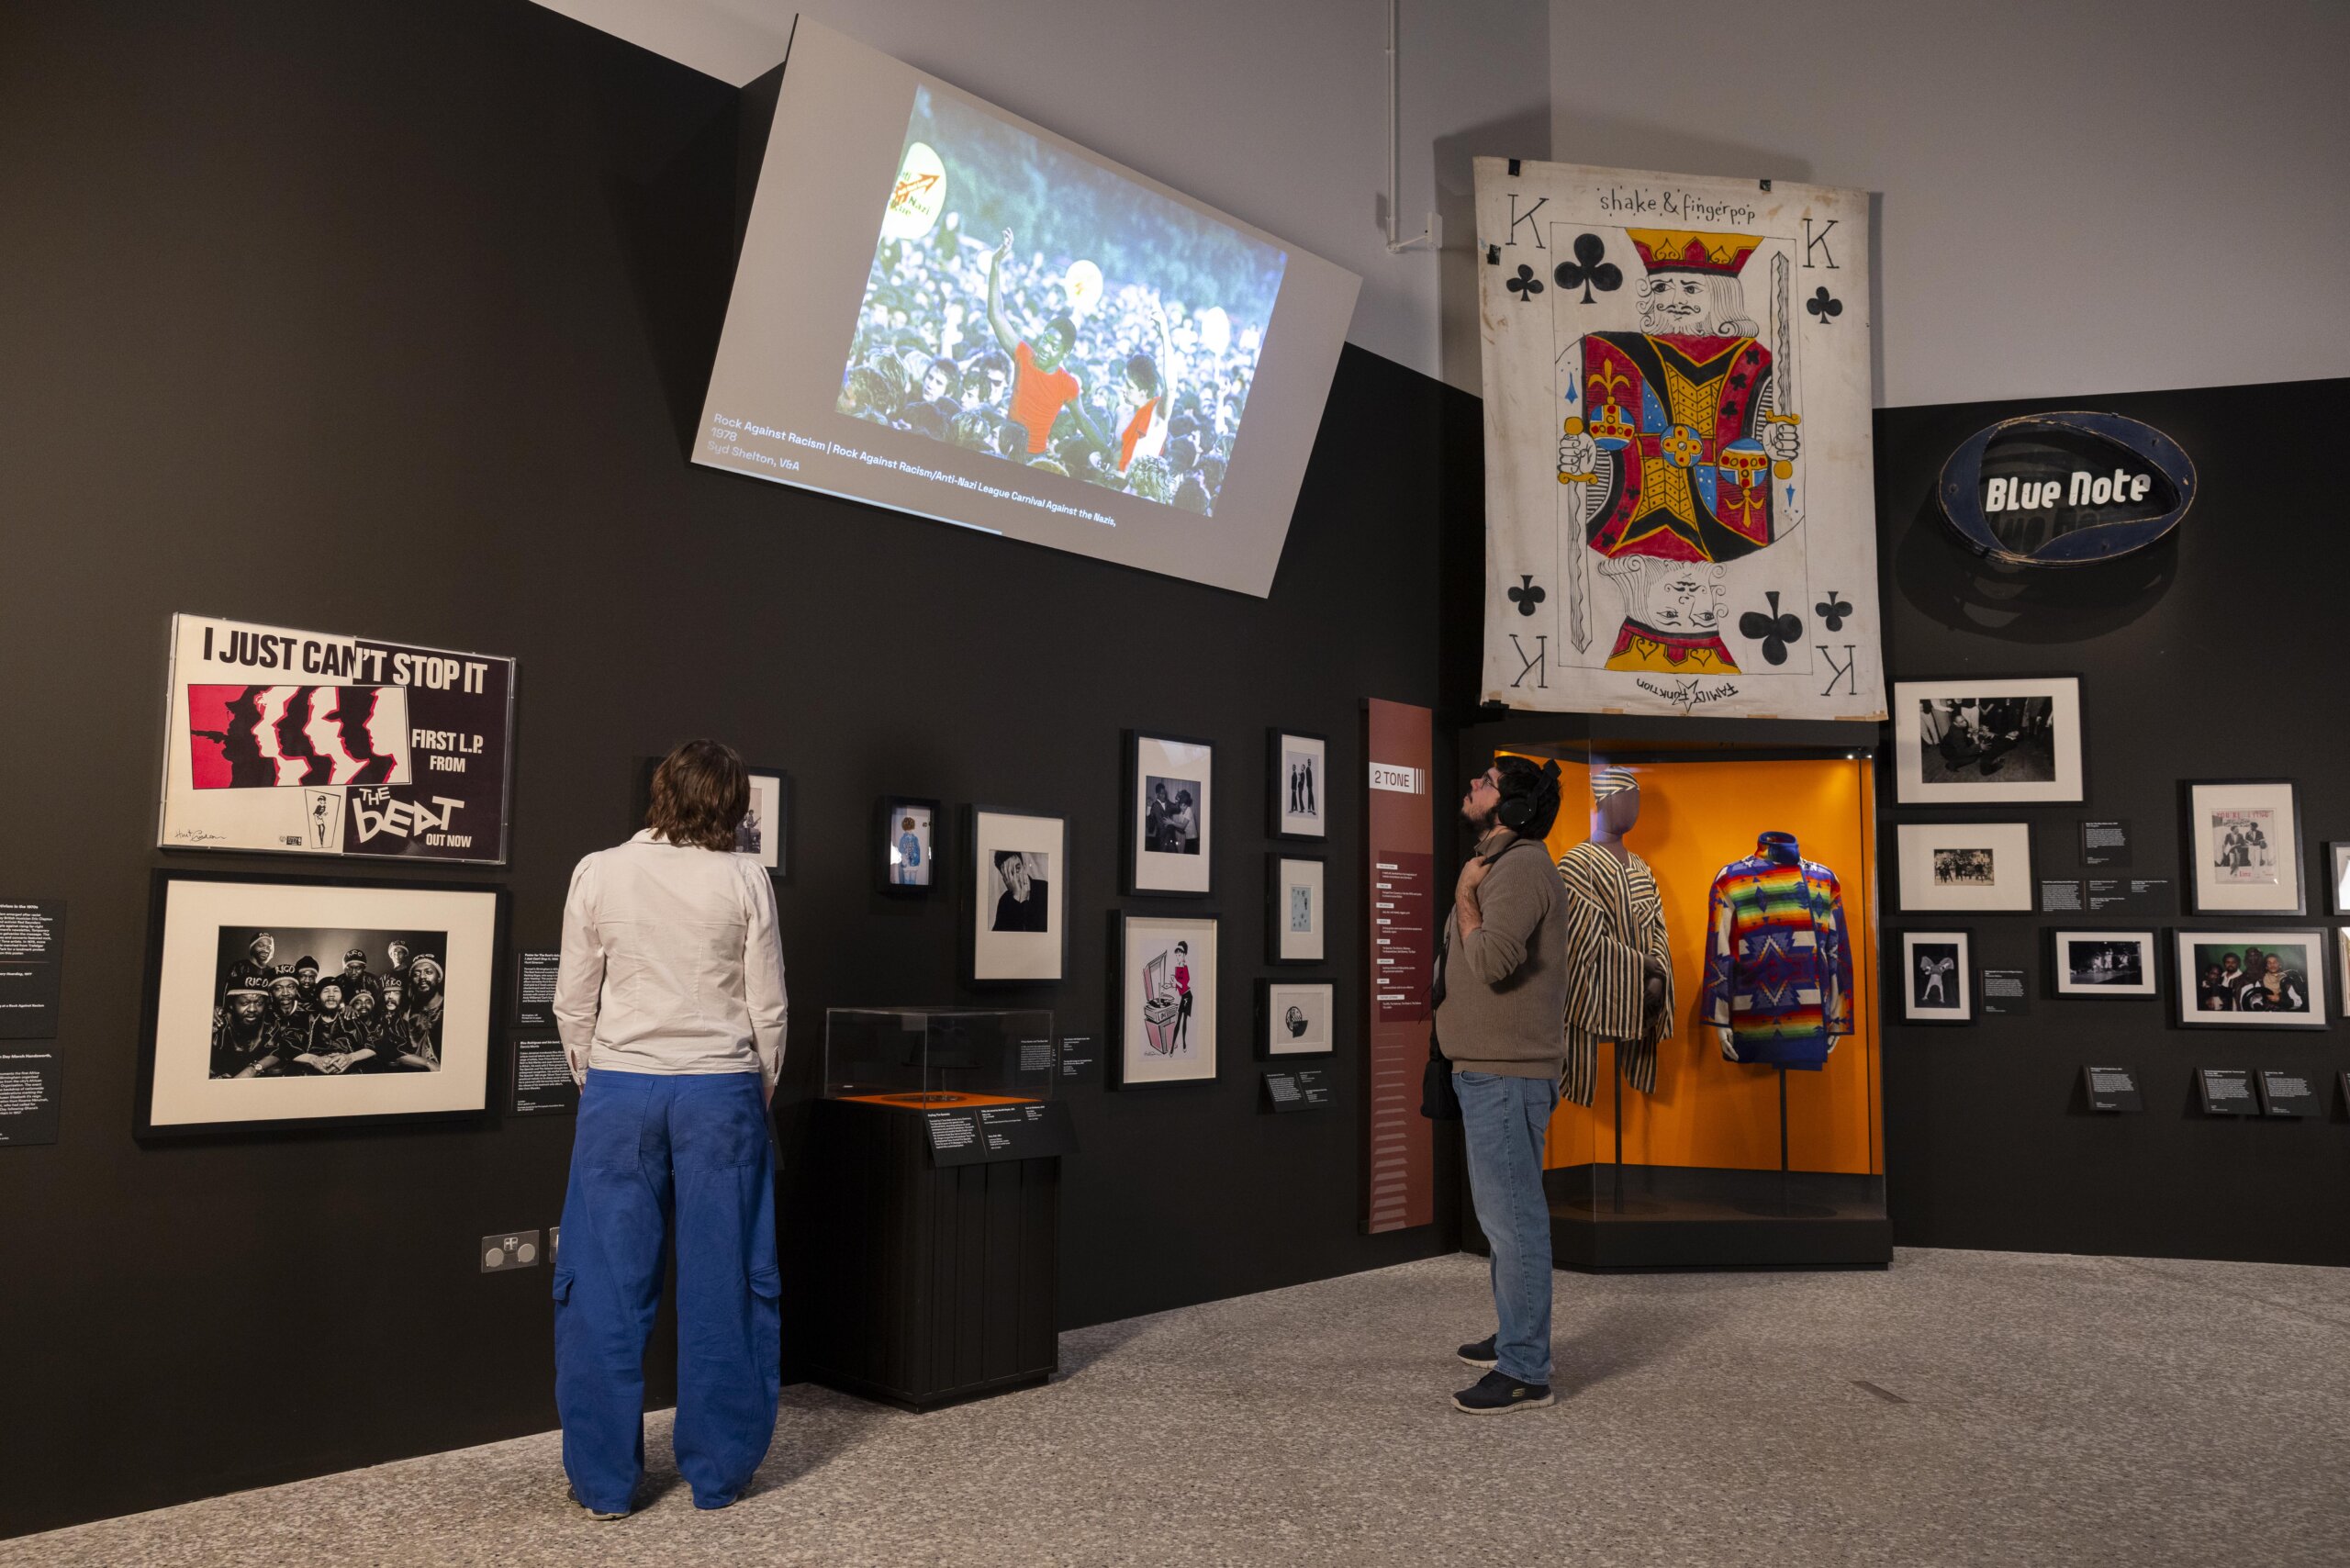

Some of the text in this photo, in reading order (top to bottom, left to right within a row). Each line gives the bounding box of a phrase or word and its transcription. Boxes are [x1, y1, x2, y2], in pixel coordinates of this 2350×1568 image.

[1506, 194, 1549, 249] K
[1600, 188, 1755, 225] shake & fingerpop
[1803, 218, 1840, 269] K
[711, 427, 738, 442] 1978
[708, 441, 800, 471] Syd Shelton, V&A
[713, 413, 742, 429] Rock
[744, 421, 787, 441] Against
[789, 433, 825, 451] Racism
[833, 444, 858, 459] Rock
[859, 451, 897, 470] Against
[899, 461, 978, 489] Racism/Anti-Nazi
[978, 482, 1010, 498] League
[1012, 491, 1046, 508] Carnival
[1046, 500, 1078, 517] Against
[1079, 510, 1092, 521] the
[1093, 512, 1116, 527] Nazis,
[1986, 468, 2151, 512] Blue Note
[203, 627, 488, 694] I JUST CAN'T STOP IT
[1509, 634, 1548, 689] K
[1816, 644, 1858, 696] K
[411, 728, 458, 753] FIRST
[430, 755, 466, 773] FROM
[1375, 770, 1410, 788] 2 TONE
[359, 787, 390, 806] THE
[426, 833, 472, 848] OUT NOW
[245, 977, 269, 988] RICO
[274, 964, 296, 975] RICO
